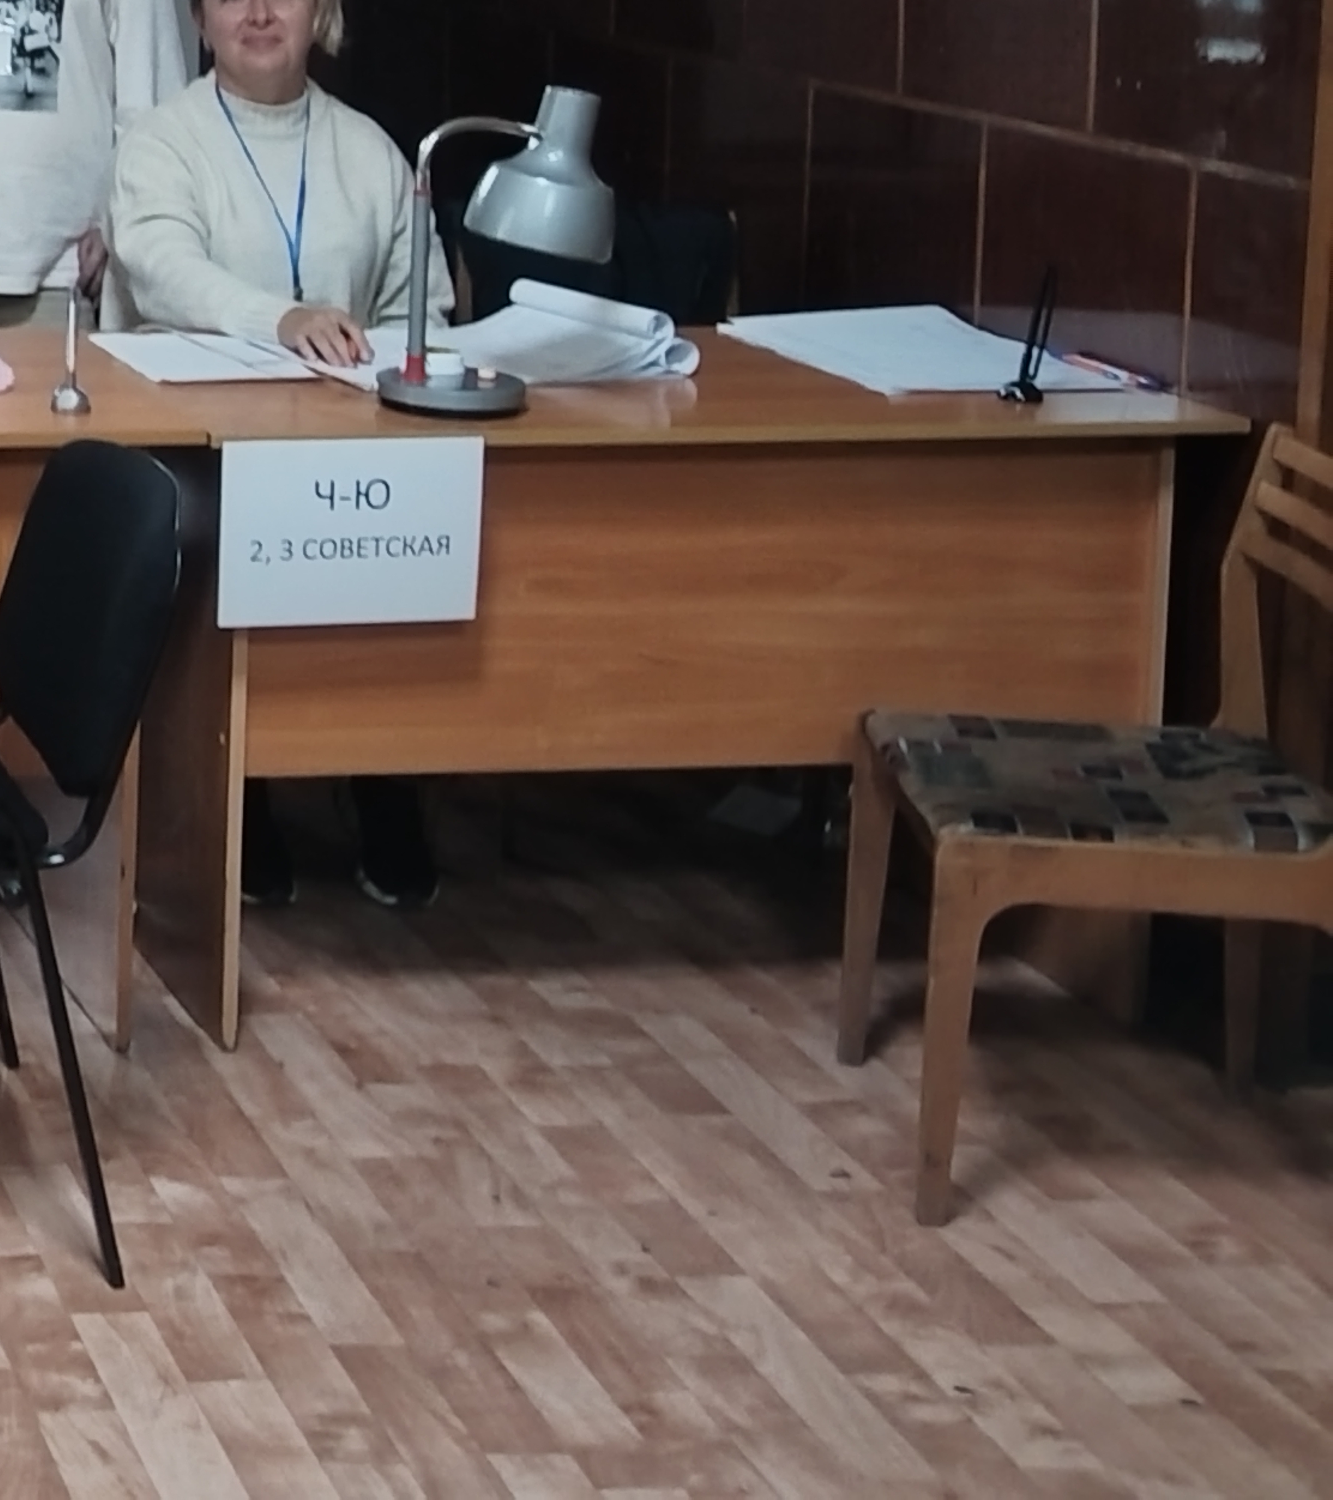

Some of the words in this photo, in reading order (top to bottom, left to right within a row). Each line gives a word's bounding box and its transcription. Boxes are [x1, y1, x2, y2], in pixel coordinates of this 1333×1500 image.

[314, 477, 391, 511] Ч-Ю
[249, 539, 272, 566] 2,
[279, 538, 294, 562] 3
[302, 534, 451, 561] СОВЕТСКАЯ
